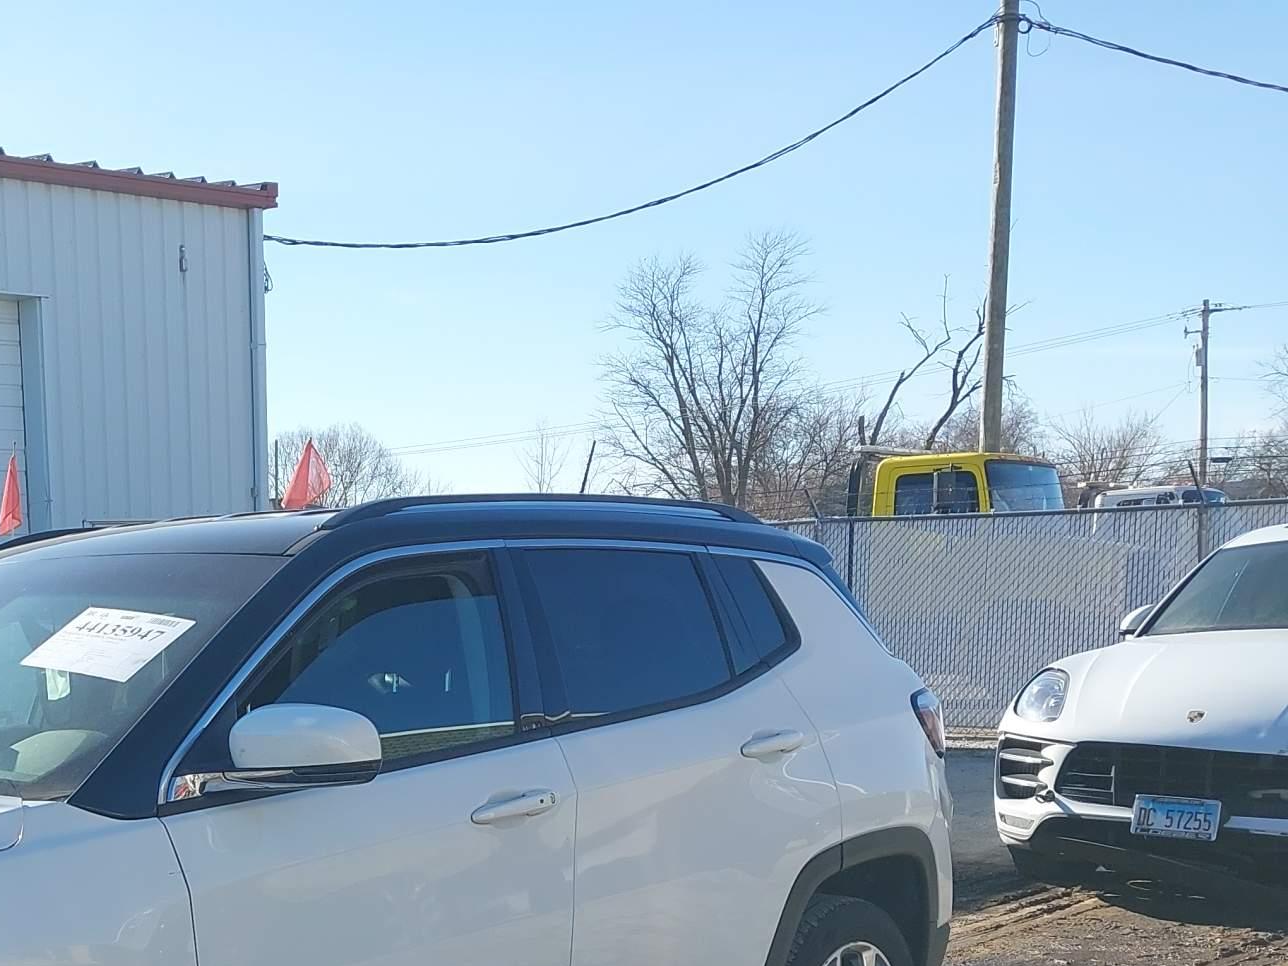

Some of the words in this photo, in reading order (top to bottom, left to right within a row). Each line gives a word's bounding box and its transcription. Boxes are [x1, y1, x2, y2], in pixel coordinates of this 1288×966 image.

[76, 620, 166, 642] 44135947
[1136, 806, 1156, 827] DC
[1164, 809, 1213, 831] 57255
